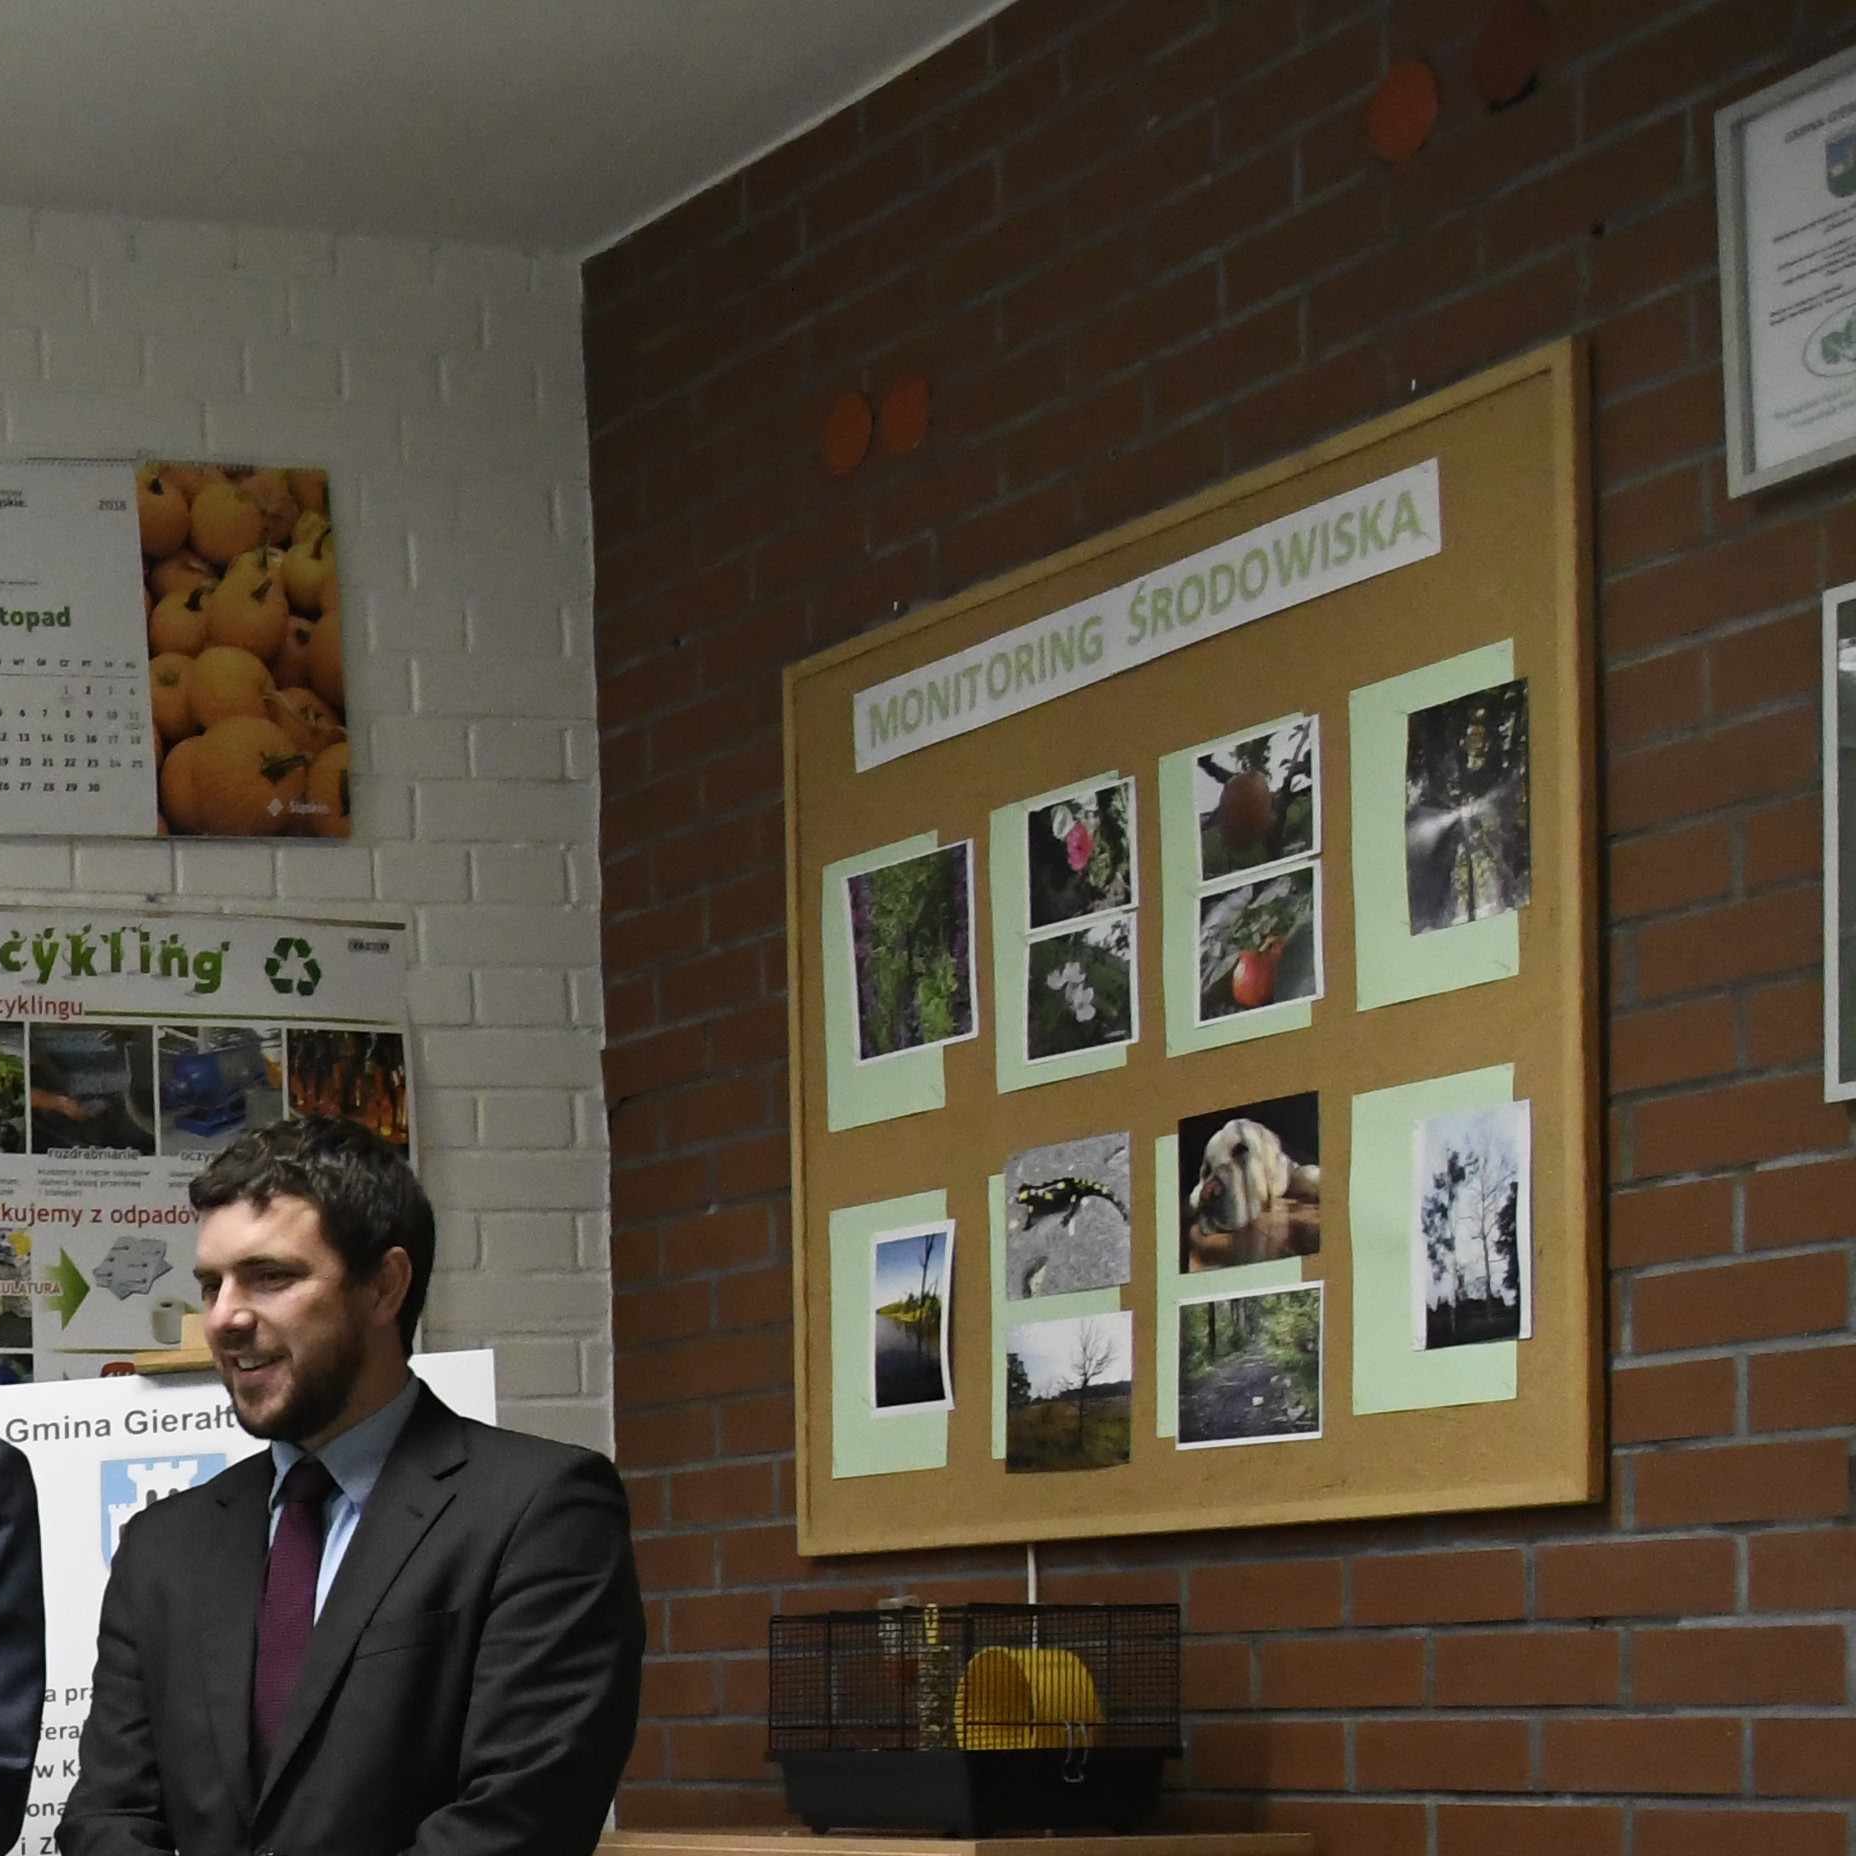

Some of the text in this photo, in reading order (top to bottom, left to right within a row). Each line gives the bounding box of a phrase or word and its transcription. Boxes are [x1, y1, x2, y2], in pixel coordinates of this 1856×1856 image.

[867, 489, 1422, 749] MONITORING ŚRODOWISKA
[43, 709, 47, 717] 7
[19, 733, 29, 741] 13
[41, 734, 52, 742] 14
[87, 735, 97, 743] 16
[20, 758, 31, 766] 20
[42, 759, 53, 767] 21
[65, 759, 76, 767] 22
[66, 783, 77, 792] 29
[88, 784, 100, 792] 30
[91, 1208, 102, 1223] z
[5, 1404, 236, 1443] Gmina Gierałt
